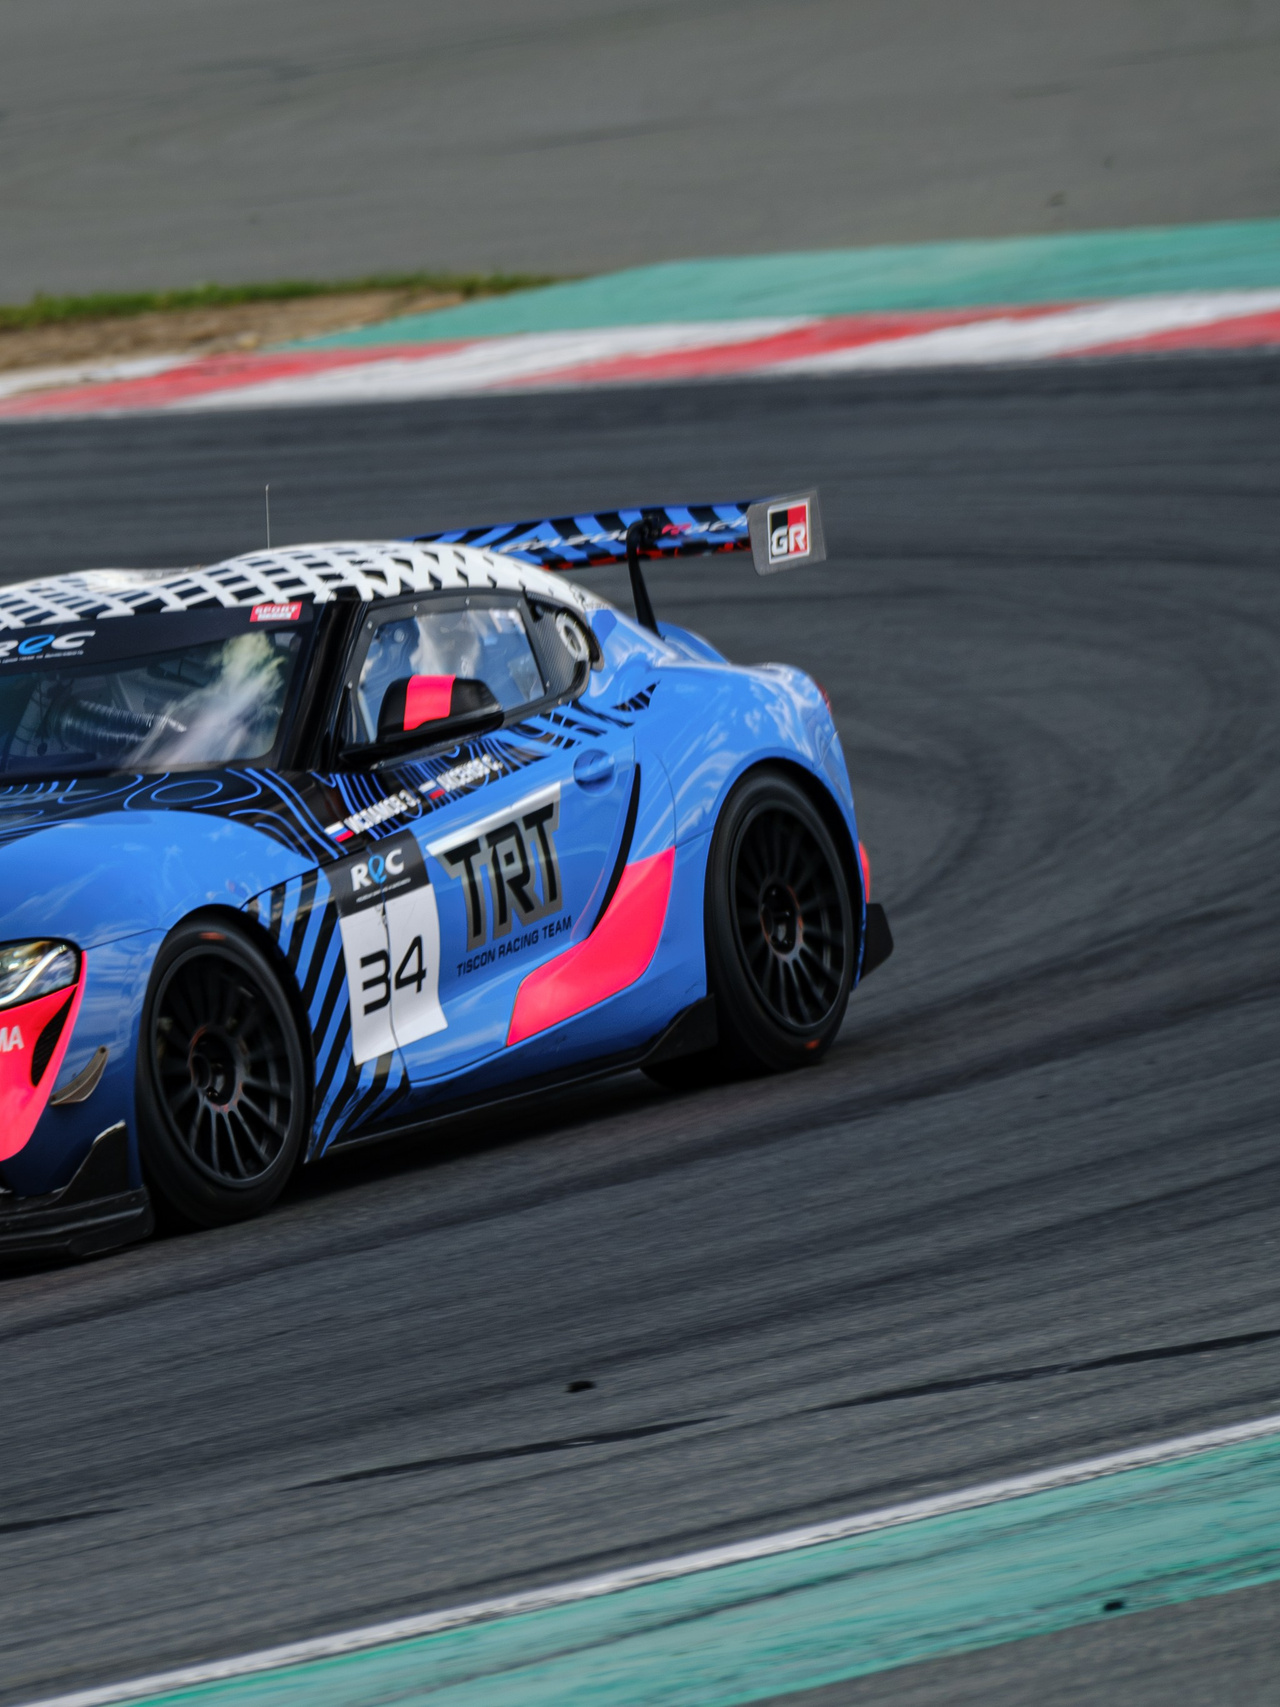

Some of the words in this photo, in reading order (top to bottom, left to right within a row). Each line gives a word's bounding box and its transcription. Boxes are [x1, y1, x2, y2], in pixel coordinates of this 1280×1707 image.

[771, 521, 807, 557] GR
[436, 798, 561, 945] TRT
[360, 935, 427, 1016] 34
[456, 948, 496, 978] TISCON
[498, 930, 539, 960] RACING
[542, 915, 572, 940] TEAM
